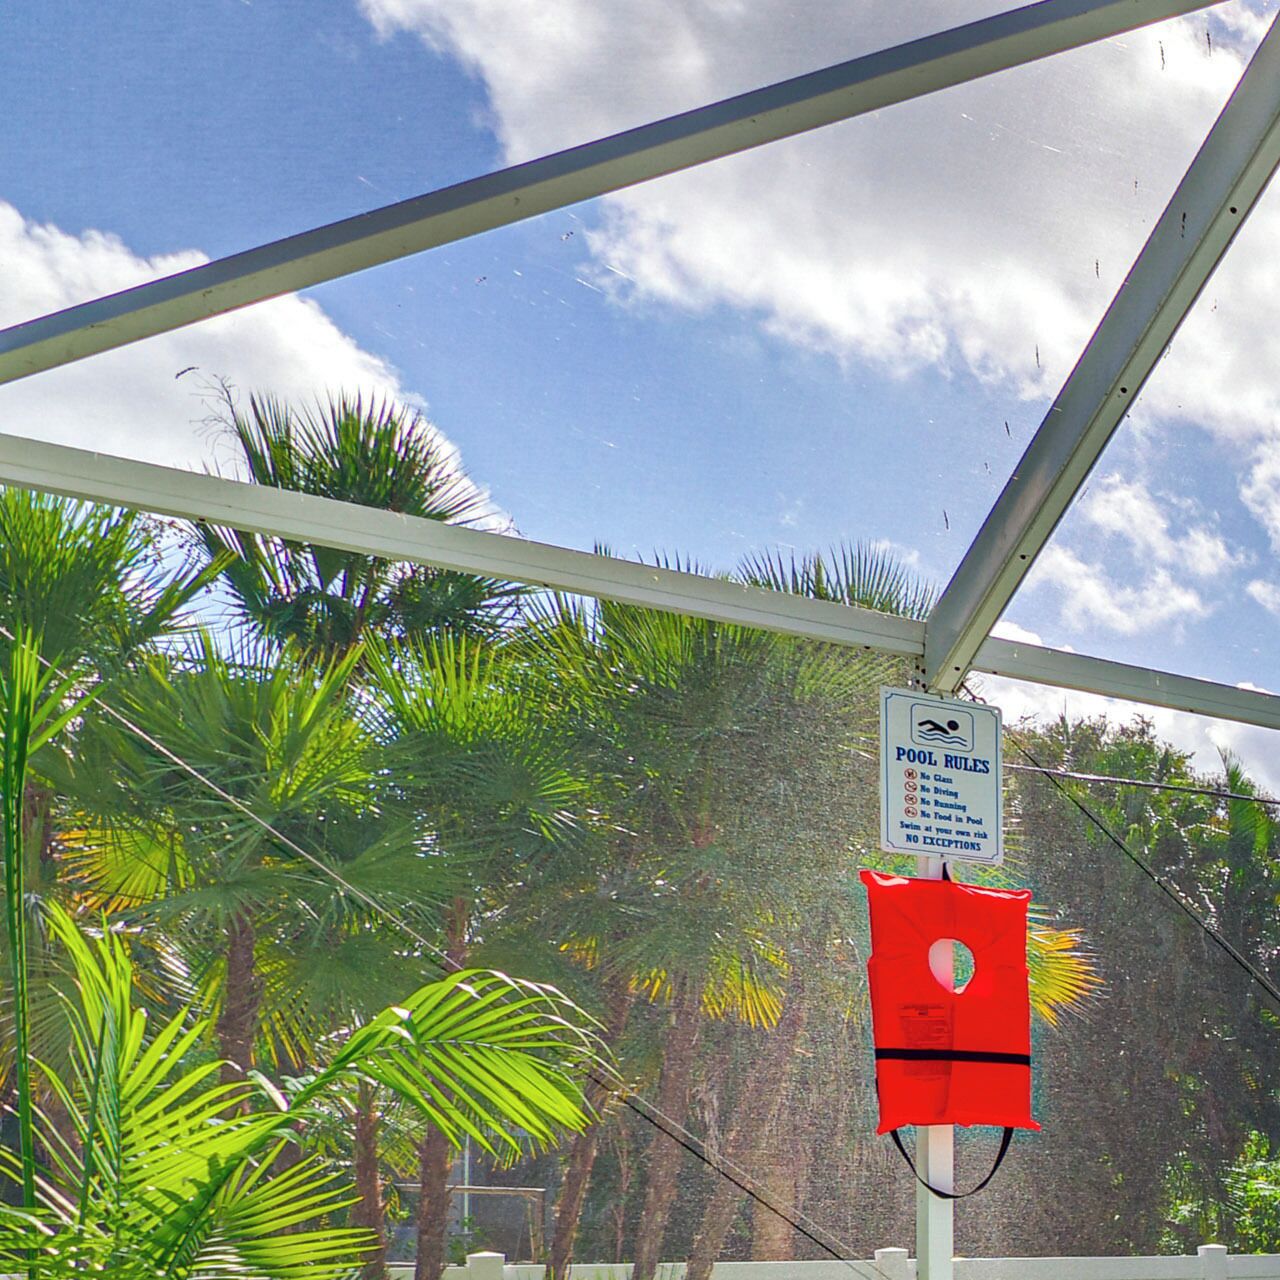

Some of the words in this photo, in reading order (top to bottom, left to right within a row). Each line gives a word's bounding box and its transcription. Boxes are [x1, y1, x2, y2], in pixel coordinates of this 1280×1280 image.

[895, 746, 937, 767] POOL
[944, 753, 990, 774] RULES
[920, 772, 930, 781] No
[933, 773, 953, 784] Glass
[920, 785, 930, 793] No
[933, 786, 959, 799] Diving
[920, 797, 931, 806] No
[933, 799, 967, 813] Running
[920, 810, 931, 819] No
[933, 811, 952, 822] Food
[955, 815, 963, 823] in
[966, 816, 983, 825] Pool
[899, 820, 921, 831] Swim
[924, 824, 932, 832] at
[935, 826, 952, 836] your
[955, 829, 971, 837] own
[974, 830, 989, 839] risk
[905, 833, 919, 845] NO
[922, 835, 982, 851] EXCEPTIONS
